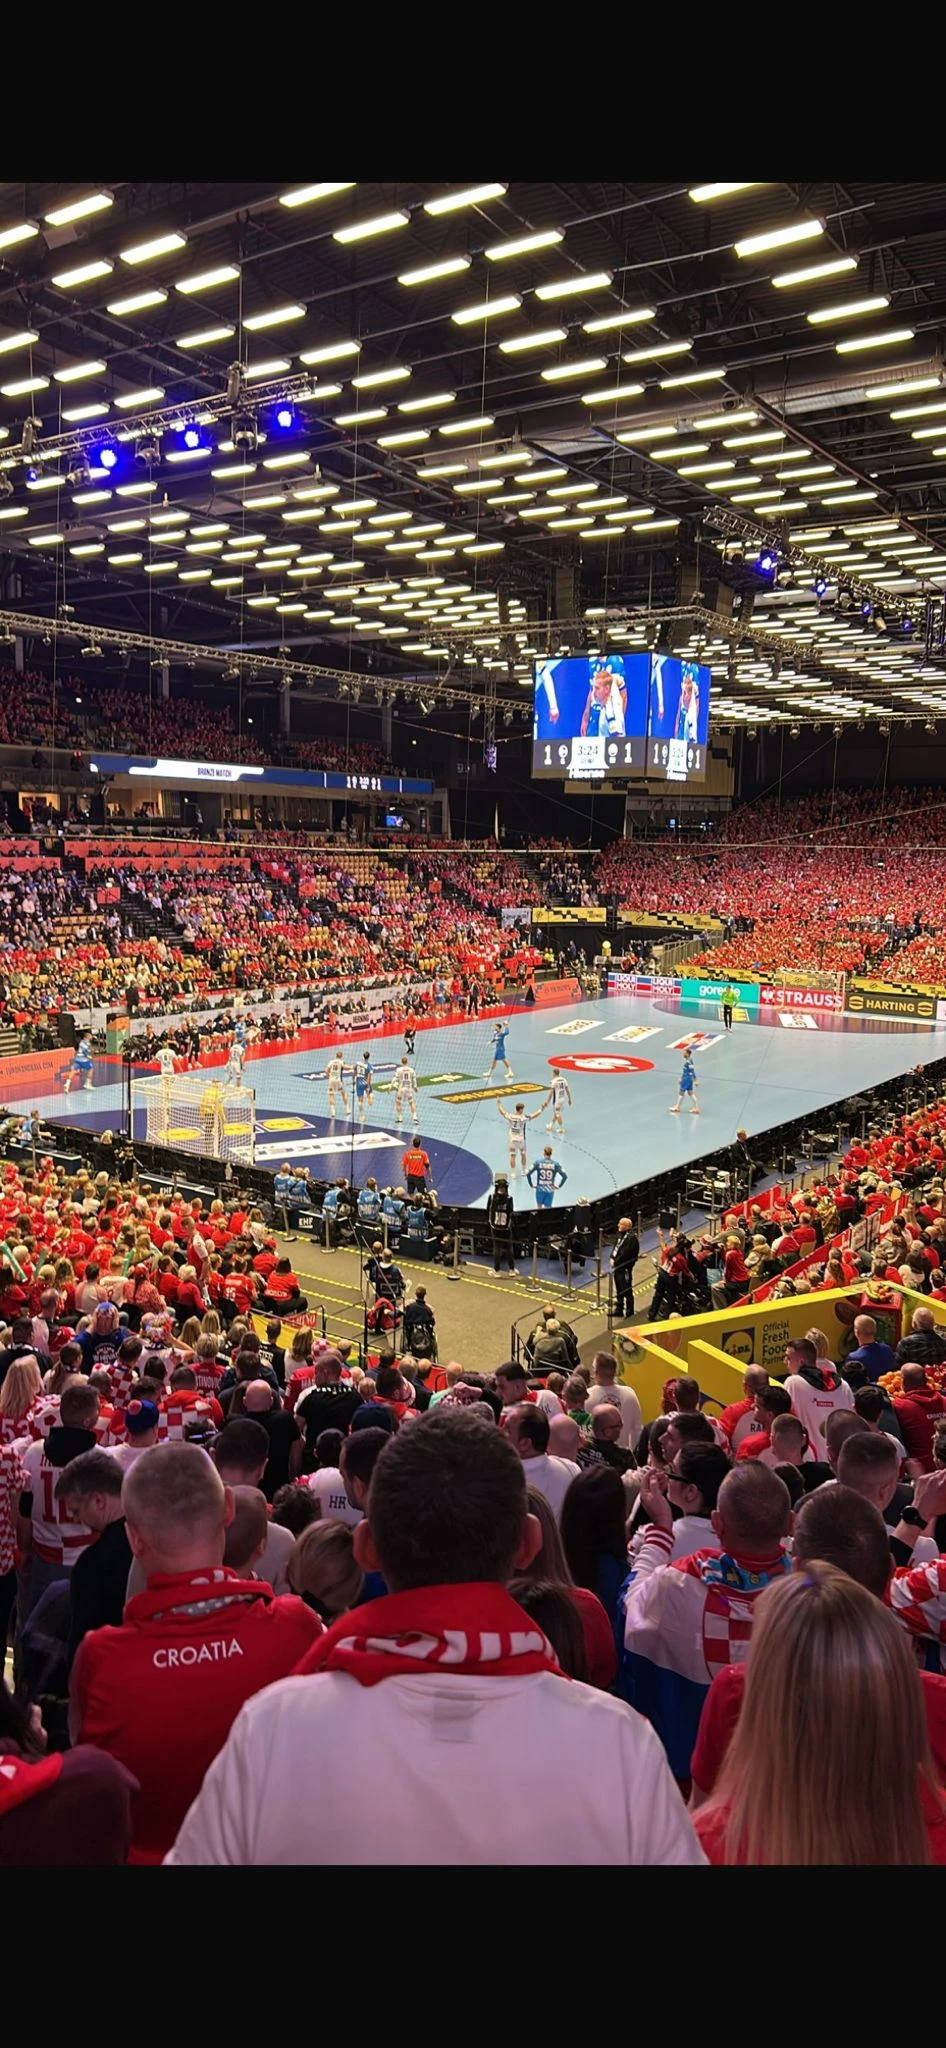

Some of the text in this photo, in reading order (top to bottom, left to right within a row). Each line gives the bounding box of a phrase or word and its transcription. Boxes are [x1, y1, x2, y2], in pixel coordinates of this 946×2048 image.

[543, 744, 553, 765] 1
[577, 745, 599, 757] 3:24
[624, 742, 633, 764] 1
[616, 974, 636, 984] LIQUI
[652, 977, 673, 988] LIQUI
[616, 982, 636, 991] MOLY
[652, 985, 673, 995] MOLY
[776, 989, 843, 1008] STRAUSS
[866, 999, 915, 1012] HARTING
[539, 1169, 553, 1180] 39
[298, 1216, 314, 1226] EHF
[762, 1320, 790, 1333] Official
[762, 1329, 790, 1344] Fresh
[153, 1638, 244, 1669] CROATIA
